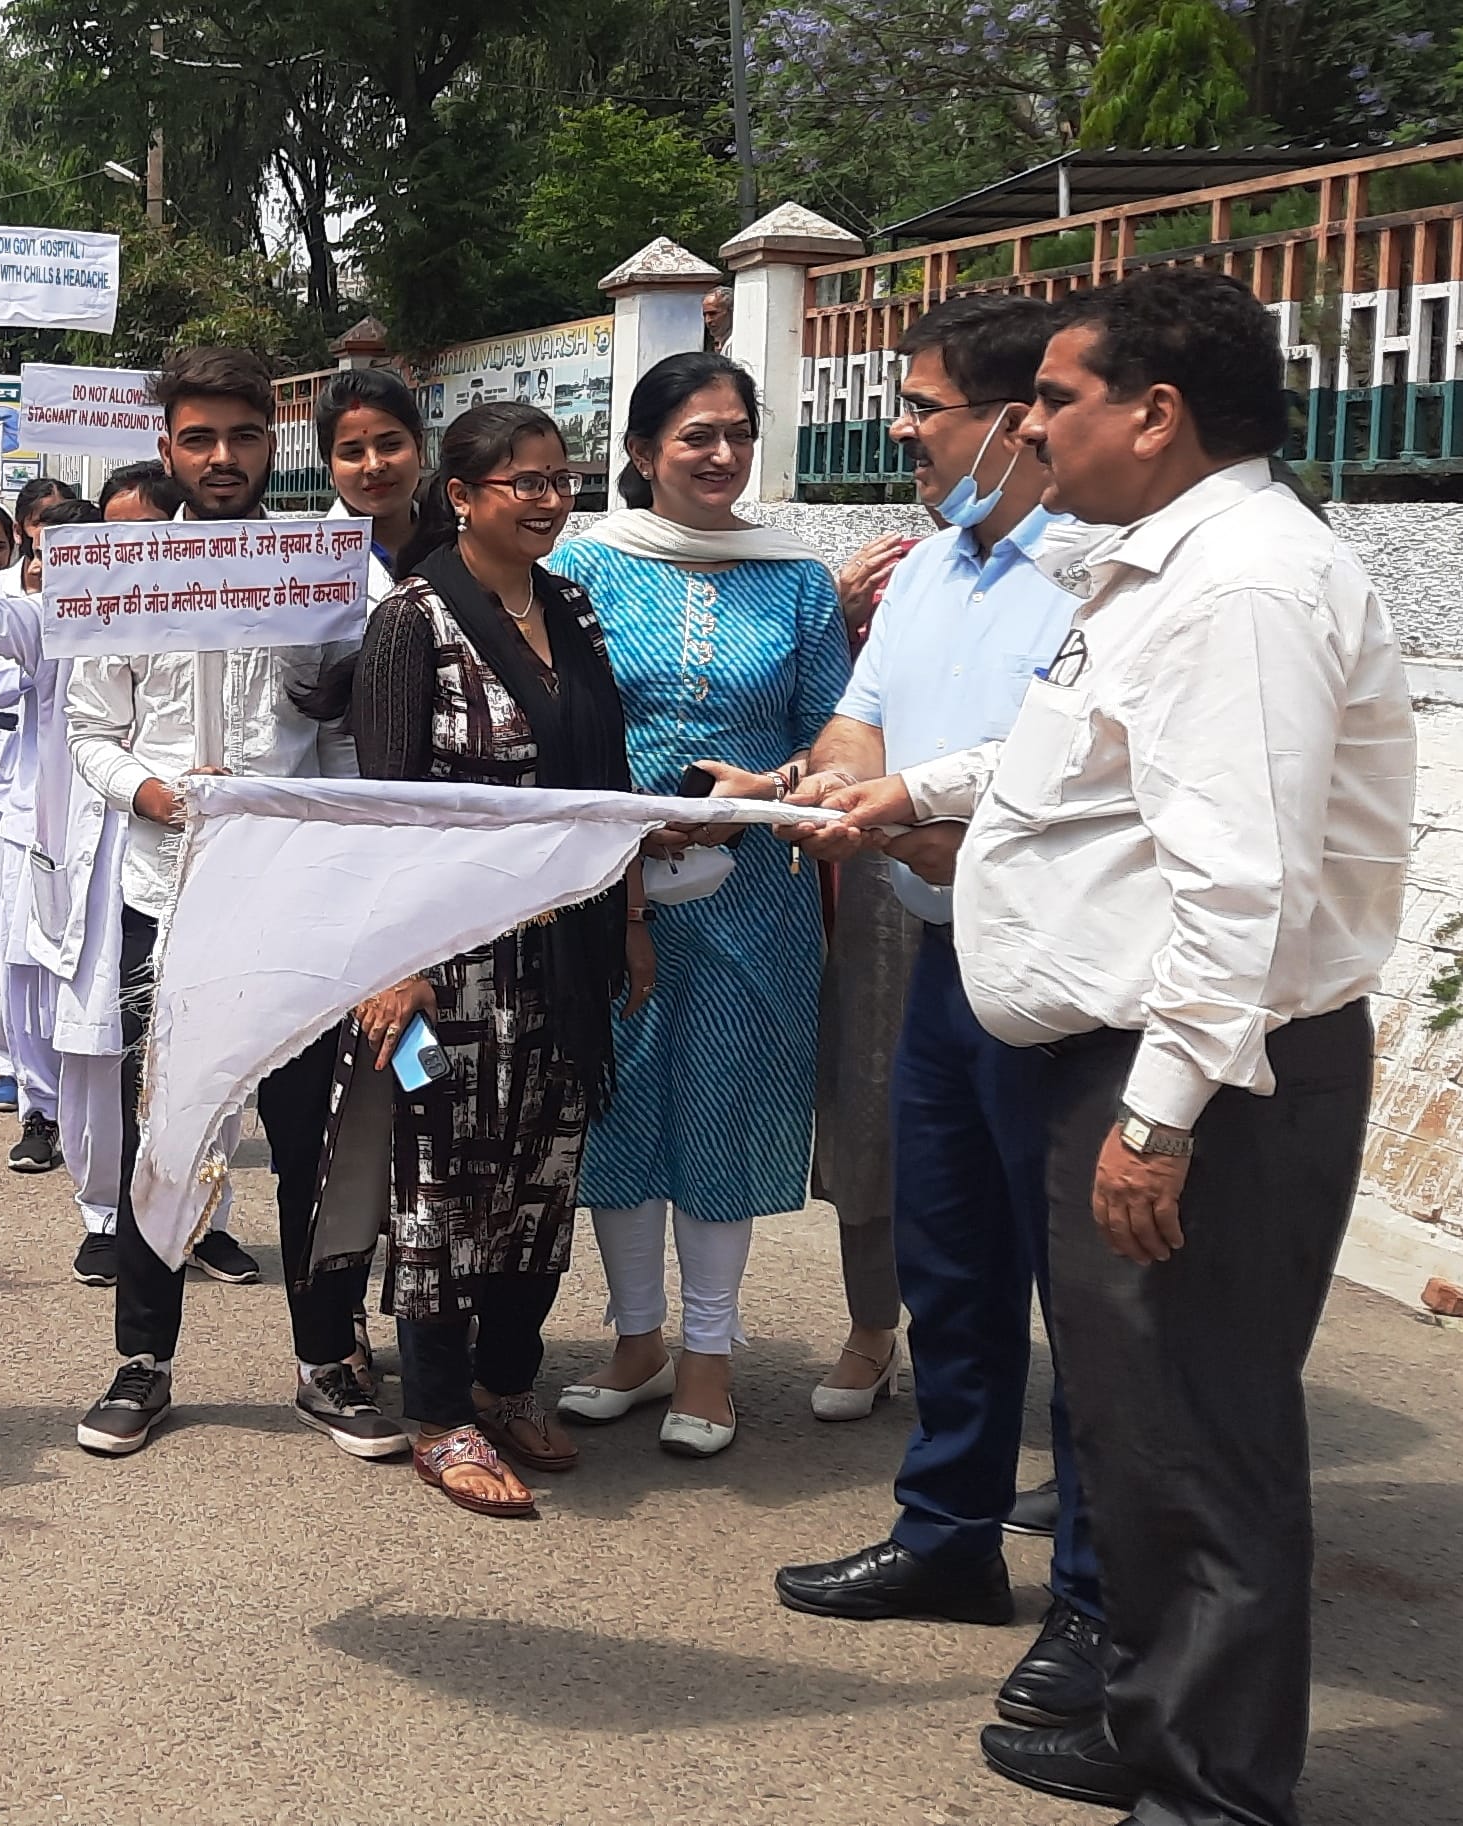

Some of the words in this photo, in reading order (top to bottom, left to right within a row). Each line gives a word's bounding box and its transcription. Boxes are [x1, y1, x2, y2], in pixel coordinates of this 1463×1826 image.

[39, 239, 80, 259] HOSPITAL
[0, 265, 22, 283] WITH
[23, 266, 54, 285] CHILLS
[55, 268, 62, 285] &
[481, 335, 527, 372] VIJAY
[529, 327, 588, 362] VARSH
[73, 385, 86, 401] DO
[89, 386, 107, 403] NOT
[28, 405, 77, 426] STAGNANT
[79, 410, 89, 426] IN
[89, 411, 109, 428] AND
[110, 413, 149, 431] AROUND
[50, 545, 81, 567] अगर
[84, 533, 111, 570] कोई
[114, 541, 144, 564] बाहर
[147, 532, 159, 562] से
[162, 529, 205, 561] मेहमान
[209, 537, 236, 558] आया
[256, 526, 277, 556] उसे
[280, 533, 312, 563] बुखार
[57, 588, 92, 619] उसके
[123, 584, 141, 615] की
[172, 581, 216, 613] मलेरिया
[273, 576, 287, 607] के
[289, 577, 310, 608] लिए
